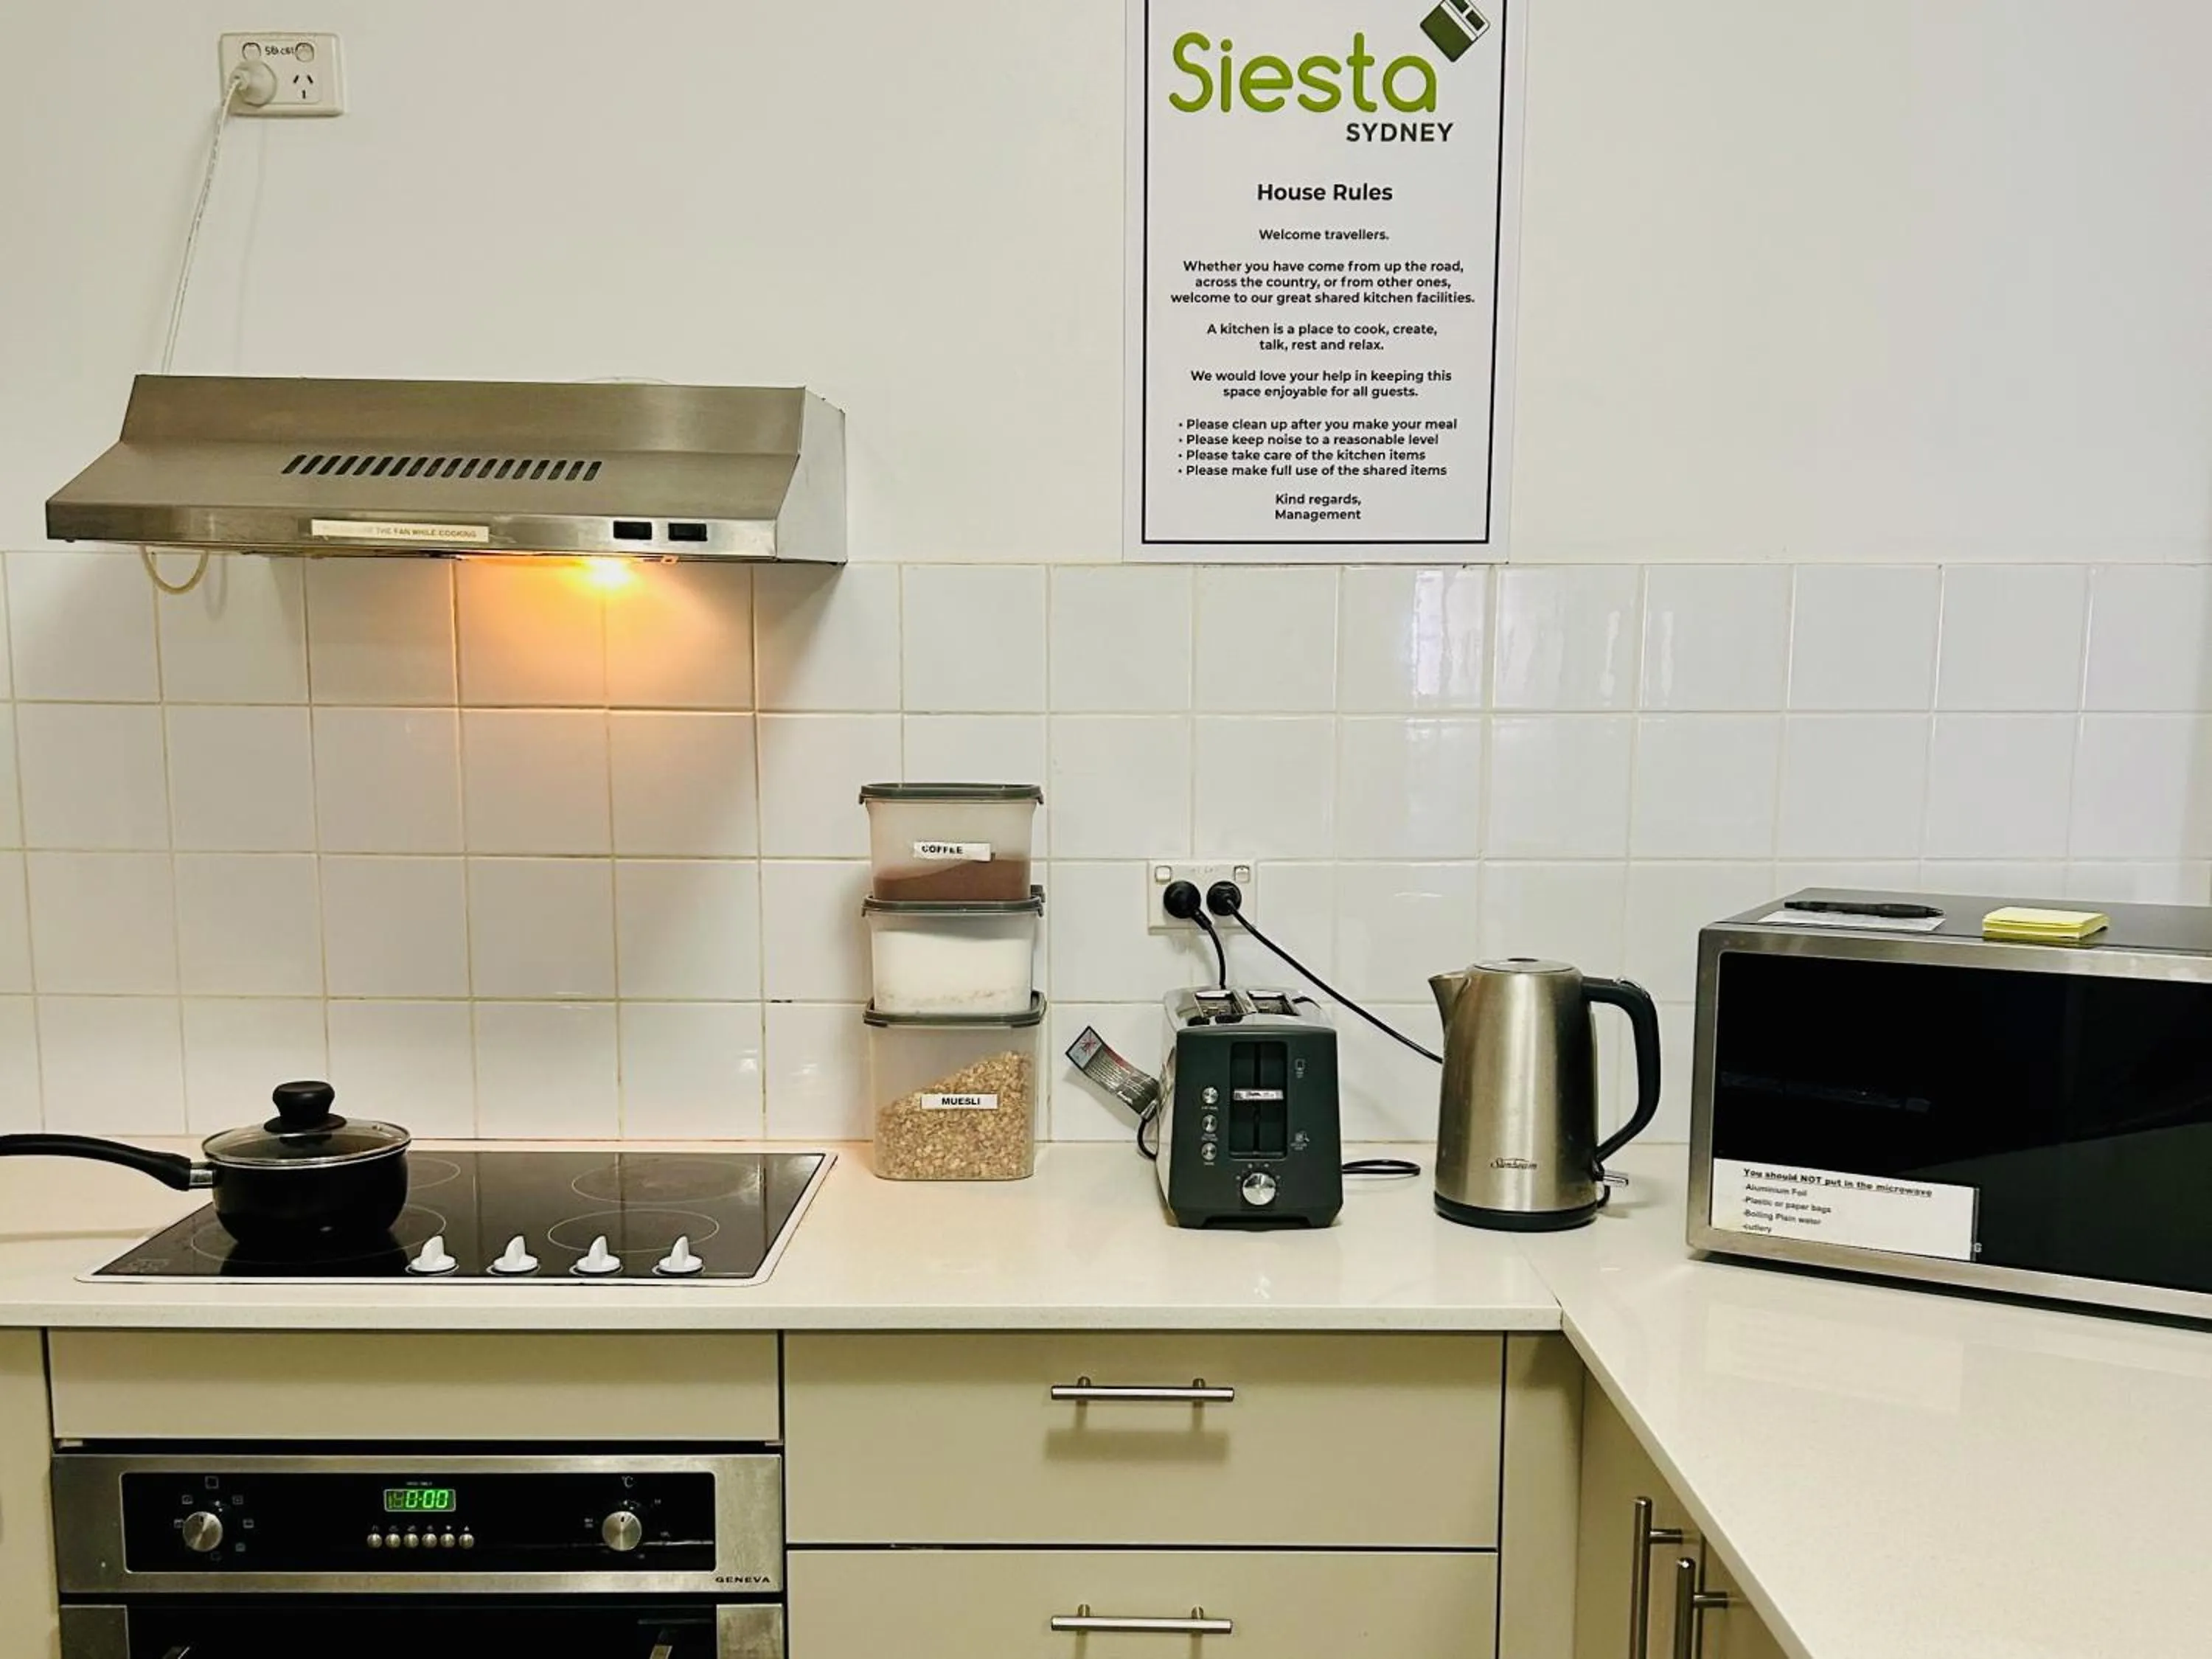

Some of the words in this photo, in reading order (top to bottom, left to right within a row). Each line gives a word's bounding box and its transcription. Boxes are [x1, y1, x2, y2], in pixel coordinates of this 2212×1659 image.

[1169, 32, 1437, 113] Siesta
[1346, 122, 1454, 142] SYDNEY
[1256, 183, 1326, 201] House
[1332, 182, 1394, 201] Rules
[1258, 228, 1322, 241] Welcome
[1324, 228, 1390, 241] travellers.
[1182, 260, 1242, 272] Whether
[1244, 262, 1270, 275] you
[1272, 260, 1305, 273] have
[1307, 262, 1346, 272] come
[1347, 260, 1381, 272] from
[1383, 262, 1402, 275] up
[1404, 260, 1427, 273] the
[1430, 260, 1464, 274] road,
[1194, 278, 1238, 288] across
[1239, 275, 1264, 288] the
[1265, 276, 1321, 291] country,
[1323, 278, 1338, 288] or
[1340, 275, 1374, 288] from
[1377, 275, 1413, 288] other
[1416, 278, 1452, 290] ones,
[1169, 291, 1231, 304] welcome
[1233, 292, 1248, 304] to
[1250, 293, 1274, 304] our
[1276, 293, 1312, 307] great
[1314, 291, 1360, 304] shared
[1363, 291, 1413, 304] kitchen
[1416, 291, 1475, 304] facilities.
[1206, 323, 1218, 335] A
[1220, 321, 1270, 335] kitchen
[1273, 321, 1284, 335] is
[1287, 325, 1295, 335] a
[1298, 322, 1335, 338] place
[1336, 324, 1352, 335] to
[1353, 322, 1390, 337] cook,
[1392, 324, 1438, 337] create,
[1259, 338, 1289, 352] talk,
[1291, 339, 1318, 351] rest
[1320, 338, 1346, 351] and
[1348, 338, 1385, 351] relax.
[1190, 369, 1213, 382] We
[1214, 369, 1256, 382] would
[1259, 369, 1287, 382] love
[1289, 372, 1320, 384] your
[1322, 369, 1352, 384] help
[1354, 369, 1368, 382] in
[1370, 369, 1425, 384] keeping
[1426, 369, 1453, 382] this
[1222, 388, 1262, 400] space
[1264, 384, 1329, 400] enjoyable
[1330, 385, 1350, 397] for
[1352, 385, 1368, 397] all
[1371, 386, 1419, 400] guests.
[1186, 418, 1229, 431] Please
[1231, 418, 1267, 431] clean
[1270, 420, 1289, 433] up
[1290, 417, 1323, 431] after
[1324, 420, 1349, 433] you
[1352, 418, 1390, 431] make
[1391, 420, 1422, 433] your
[1425, 418, 1458, 431] meal
[1186, 433, 1229, 445] Please
[1231, 434, 1265, 448] keep
[1267, 433, 1303, 445] noise
[1305, 434, 1320, 445] to
[1321, 435, 1330, 445] a
[1333, 433, 1405, 445] reasonable
[1408, 433, 1439, 445] level
[1186, 448, 1229, 461] Please
[1231, 449, 1261, 461] take
[1263, 451, 1293, 461] care
[1295, 448, 1310, 461] of
[1311, 448, 1334, 461] the
[1336, 448, 1386, 461] kitchen
[1388, 448, 1427, 461] items
[1186, 464, 1229, 476] Please
[1231, 464, 1269, 476] make
[1270, 464, 1293, 476] full
[1295, 466, 1318, 476] use
[1321, 464, 1335, 476] of
[1337, 464, 1360, 476] the
[1362, 463, 1408, 476] shared
[1410, 463, 1448, 476] items
[1275, 492, 1306, 505] Kind
[1308, 493, 1362, 507] regards,
[1274, 509, 1362, 524] Management
[942, 1097, 981, 1105] MUESLI
[1743, 1168, 1763, 1178] You
[1764, 1170, 1798, 1182] should
[1799, 1175, 1823, 1184] NOT
[1825, 1178, 1842, 1188] put
[1844, 1180, 1854, 1188] in
[1857, 1181, 1874, 1190] the
[1876, 1183, 1933, 1197] microwave
